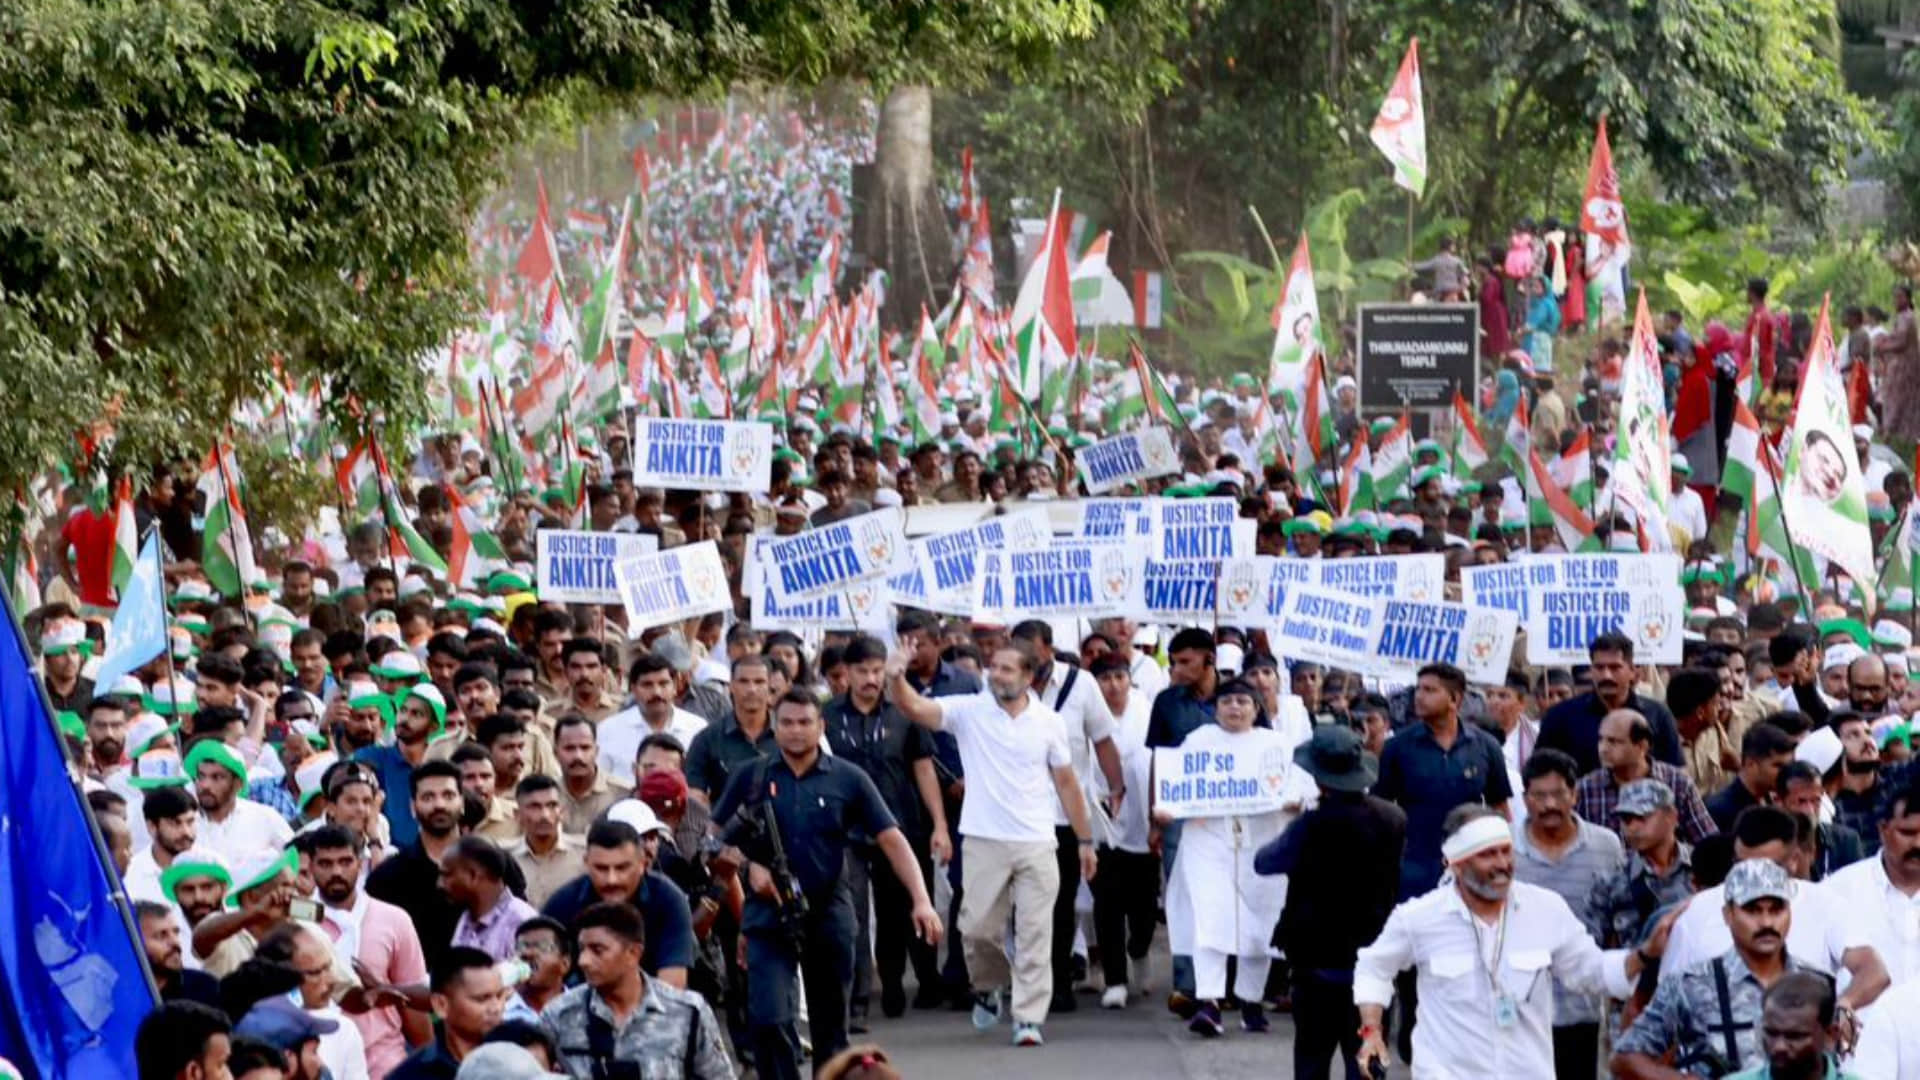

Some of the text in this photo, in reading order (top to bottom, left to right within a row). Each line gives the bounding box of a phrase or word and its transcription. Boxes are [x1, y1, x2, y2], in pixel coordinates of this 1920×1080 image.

[1400, 355, 1437, 368] TEMPLE
[648, 421, 725, 443] JUSTICE FOR
[647, 442, 722, 476] ANKITA
[1083, 440, 1118, 462] JUSTICE
[1090, 450, 1145, 483] ANKITA
[1162, 502, 1234, 525] JUSTICE FOR
[548, 535, 617, 555] JUSTICE FOR
[771, 532, 825, 564] JUSTICE
[825, 525, 853, 549] FOR
[926, 522, 1005, 559] JUSTICE FOR
[1164, 525, 1233, 560] ANKITA
[549, 556, 617, 589] ANKITA
[780, 546, 862, 594] ANKITA
[1011, 551, 1063, 573] JUSTICE
[1066, 549, 1093, 570] FOR
[1321, 561, 1397, 585] JUSTICE FOR
[1592, 559, 1618, 580] FOR
[1014, 572, 1093, 608] ANKITA
[1473, 563, 1556, 592] JUSTICE FOR
[630, 575, 690, 616] ANKITA
[1144, 579, 1217, 610] ANKITA
[1294, 592, 1352, 624] JUSTICE
[1543, 591, 1630, 614] JUSTICE FOR
[1384, 601, 1467, 629] JUSTICE FOR
[1377, 623, 1459, 664] ANKITA
[1184, 751, 1234, 774] BJP se
[1160, 776, 1258, 802] Beti Bachao
